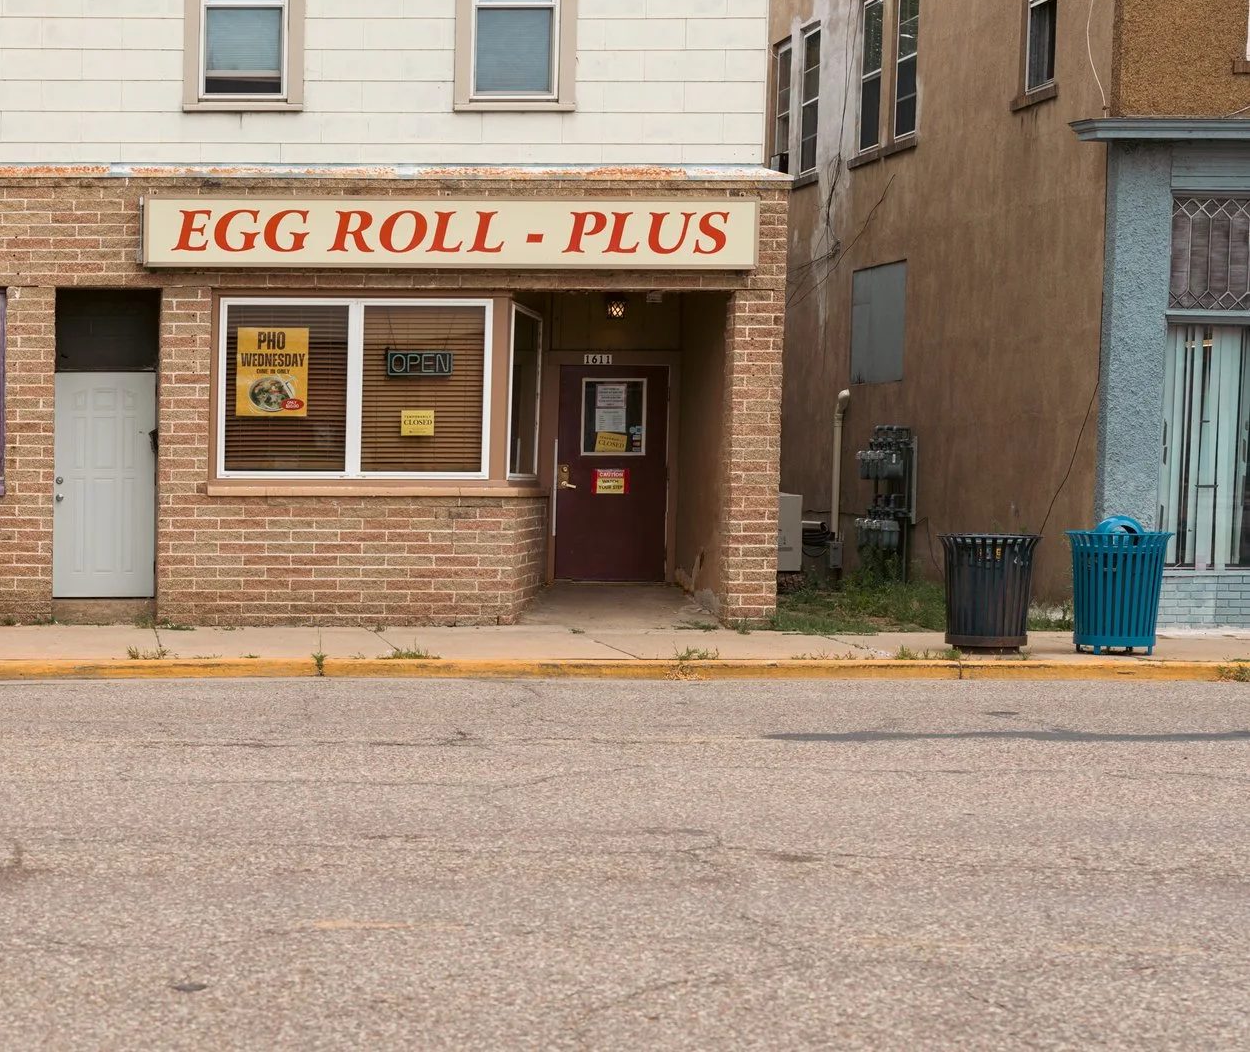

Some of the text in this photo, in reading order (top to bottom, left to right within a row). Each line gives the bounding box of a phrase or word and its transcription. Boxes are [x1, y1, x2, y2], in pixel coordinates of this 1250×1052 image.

[171, 209, 730, 255] EGG ROLL - PLUS
[257, 331, 286, 350] PHO
[241, 353, 305, 367] WEDNESDAY
[392, 354, 450, 372] OPEN
[585, 355, 611, 364] 1611
[598, 439, 625, 448] CLOSED
